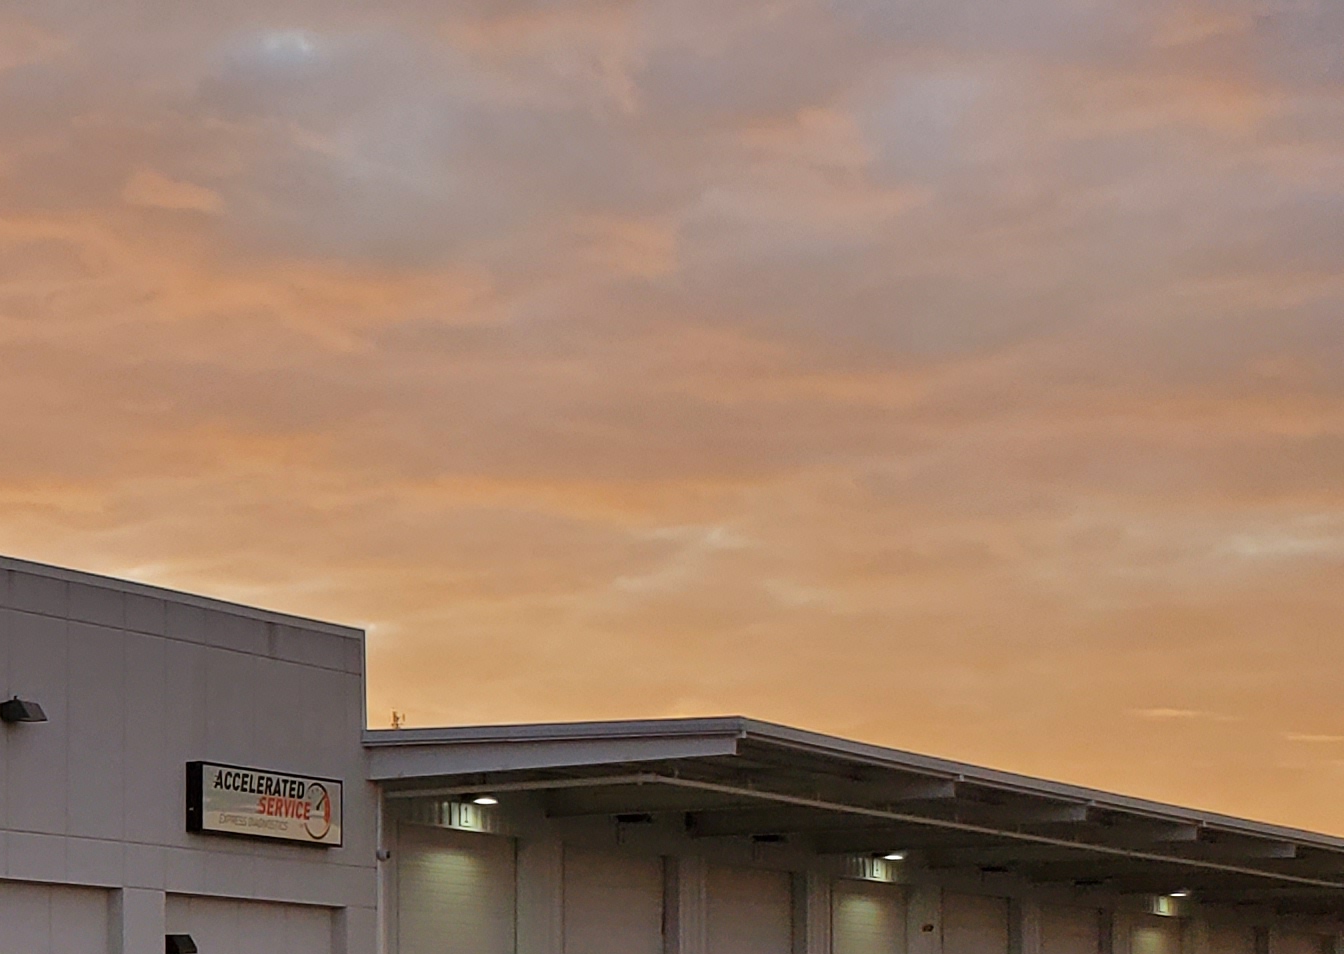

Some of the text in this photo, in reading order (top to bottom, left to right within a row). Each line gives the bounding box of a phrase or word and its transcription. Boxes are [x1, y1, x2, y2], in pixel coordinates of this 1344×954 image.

[213, 769, 305, 799] ACCELERATED
[218, 813, 247, 827] EXPRESS
[256, 796, 312, 821] SERVICE
